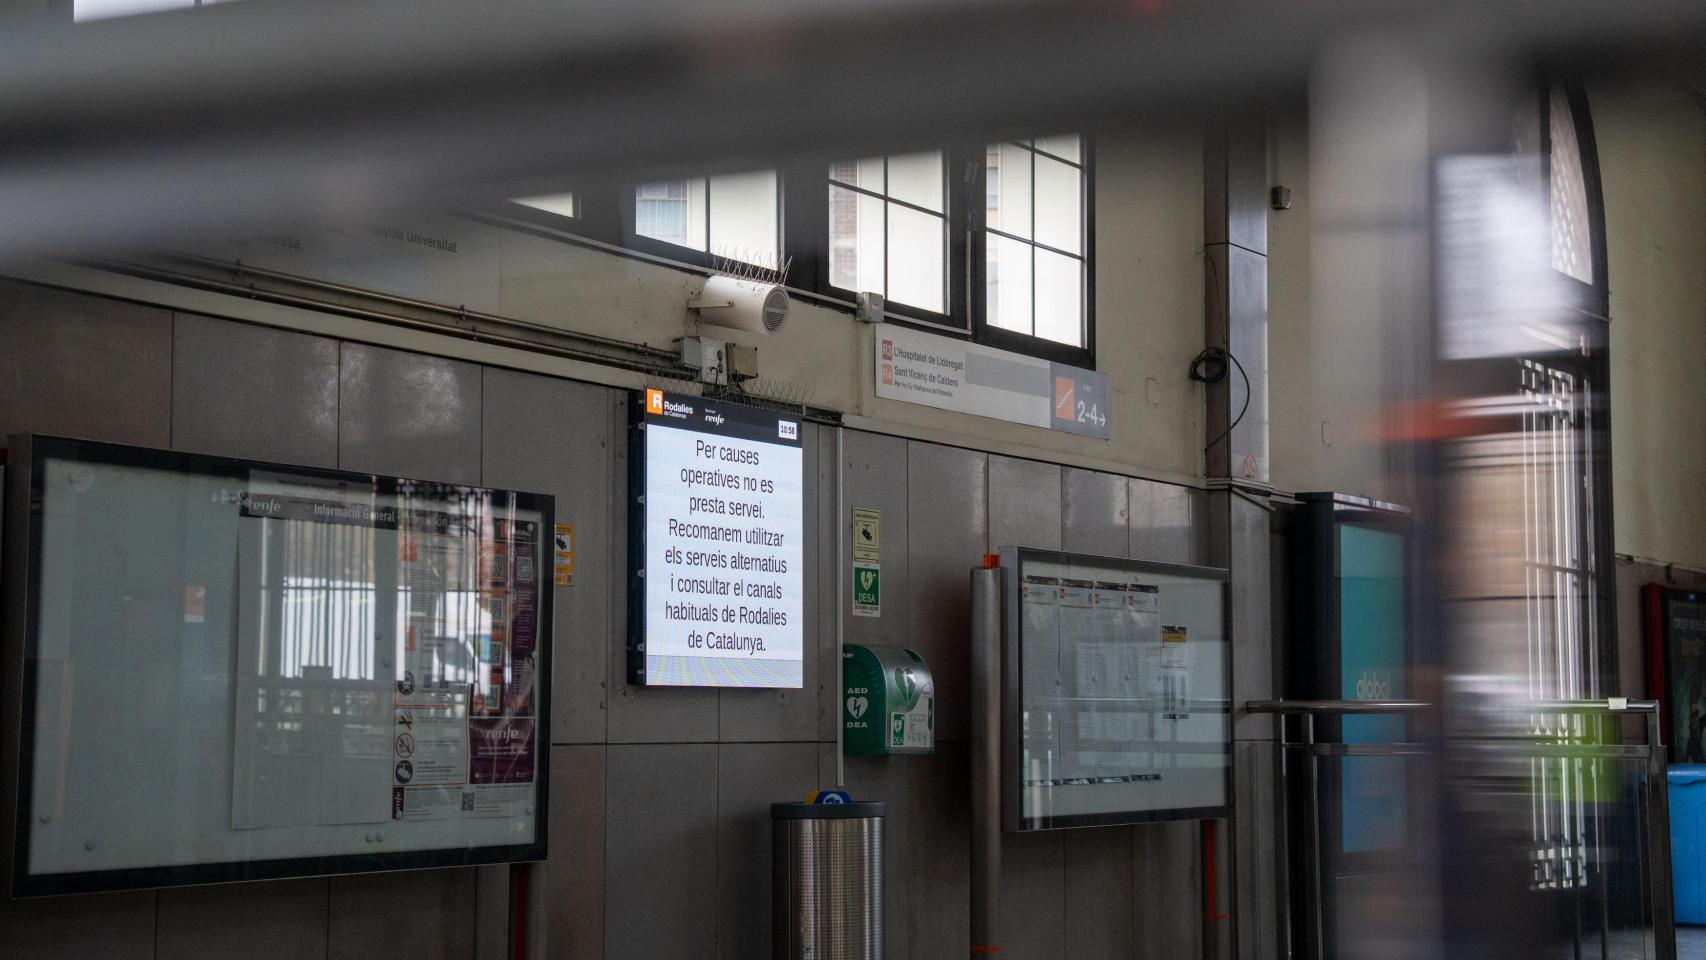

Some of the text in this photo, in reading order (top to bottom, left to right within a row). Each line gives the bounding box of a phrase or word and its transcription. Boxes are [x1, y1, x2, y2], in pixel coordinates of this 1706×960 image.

[406, 229, 457, 254] Universitat
[893, 346, 963, 371] L'Hospitalet de Llobregat
[894, 365, 908, 377] Sant
[928, 373, 936, 383] de
[652, 392, 663, 409] R
[664, 400, 693, 415] Rodalies
[1077, 399, 1098, 425] 2-4
[705, 414, 725, 426] renfe
[780, 425, 795, 435] 10:58
[696, 439, 759, 466] Per causes
[680, 467, 774, 494] operatives no es
[314, 503, 360, 519] Informació
[689, 496, 765, 519] presta servei.
[669, 518, 784, 547] Recomanem utilitzar
[665, 546, 787, 574] els serveis alternatius
[670, 573, 783, 600] i consultar el canals
[858, 592, 876, 604] DESA
[665, 600, 787, 627] habituals de Rodalies
[687, 629, 766, 656] de Catalunya.
[486, 724, 520, 743] renfe
